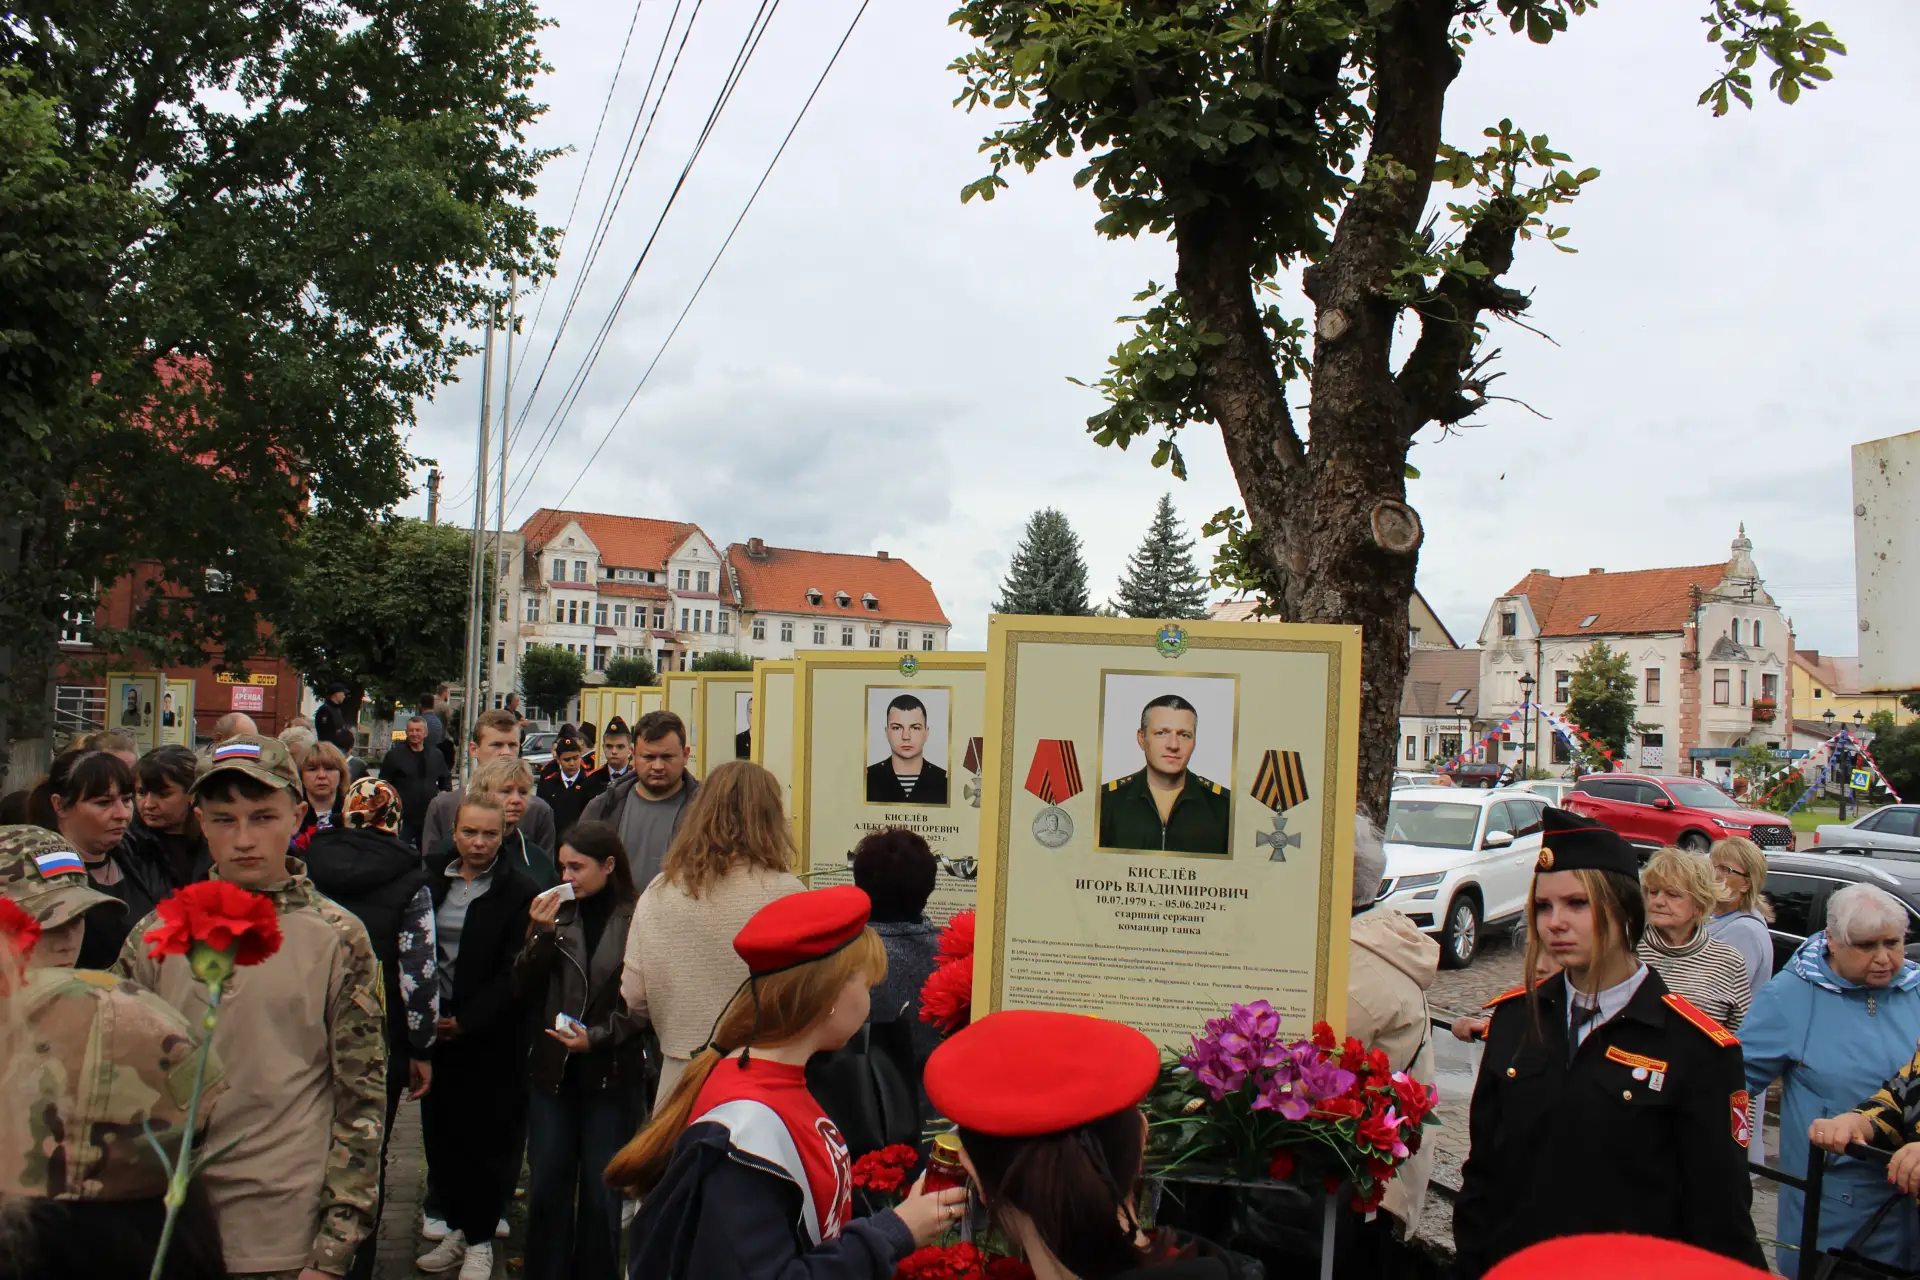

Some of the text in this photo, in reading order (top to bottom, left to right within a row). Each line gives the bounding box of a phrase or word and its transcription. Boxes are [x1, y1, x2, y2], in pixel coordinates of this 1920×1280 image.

[885, 813, 928, 822] КИСЕЛЁВ
[910, 825, 959, 833] ИГОРЕВИЧ
[1128, 866, 1196, 880] КИСЕЛЁВ
[1075, 879, 1248, 899] ИГОРЬ ВЛАДИМИРОВИЧ
[1096, 895, 1147, 907] 10.07.1979
[1166, 900, 1216, 911] 05.06.2024
[1115, 910, 1206, 923] старший сержант
[1118, 924, 1201, 935] командир танка
